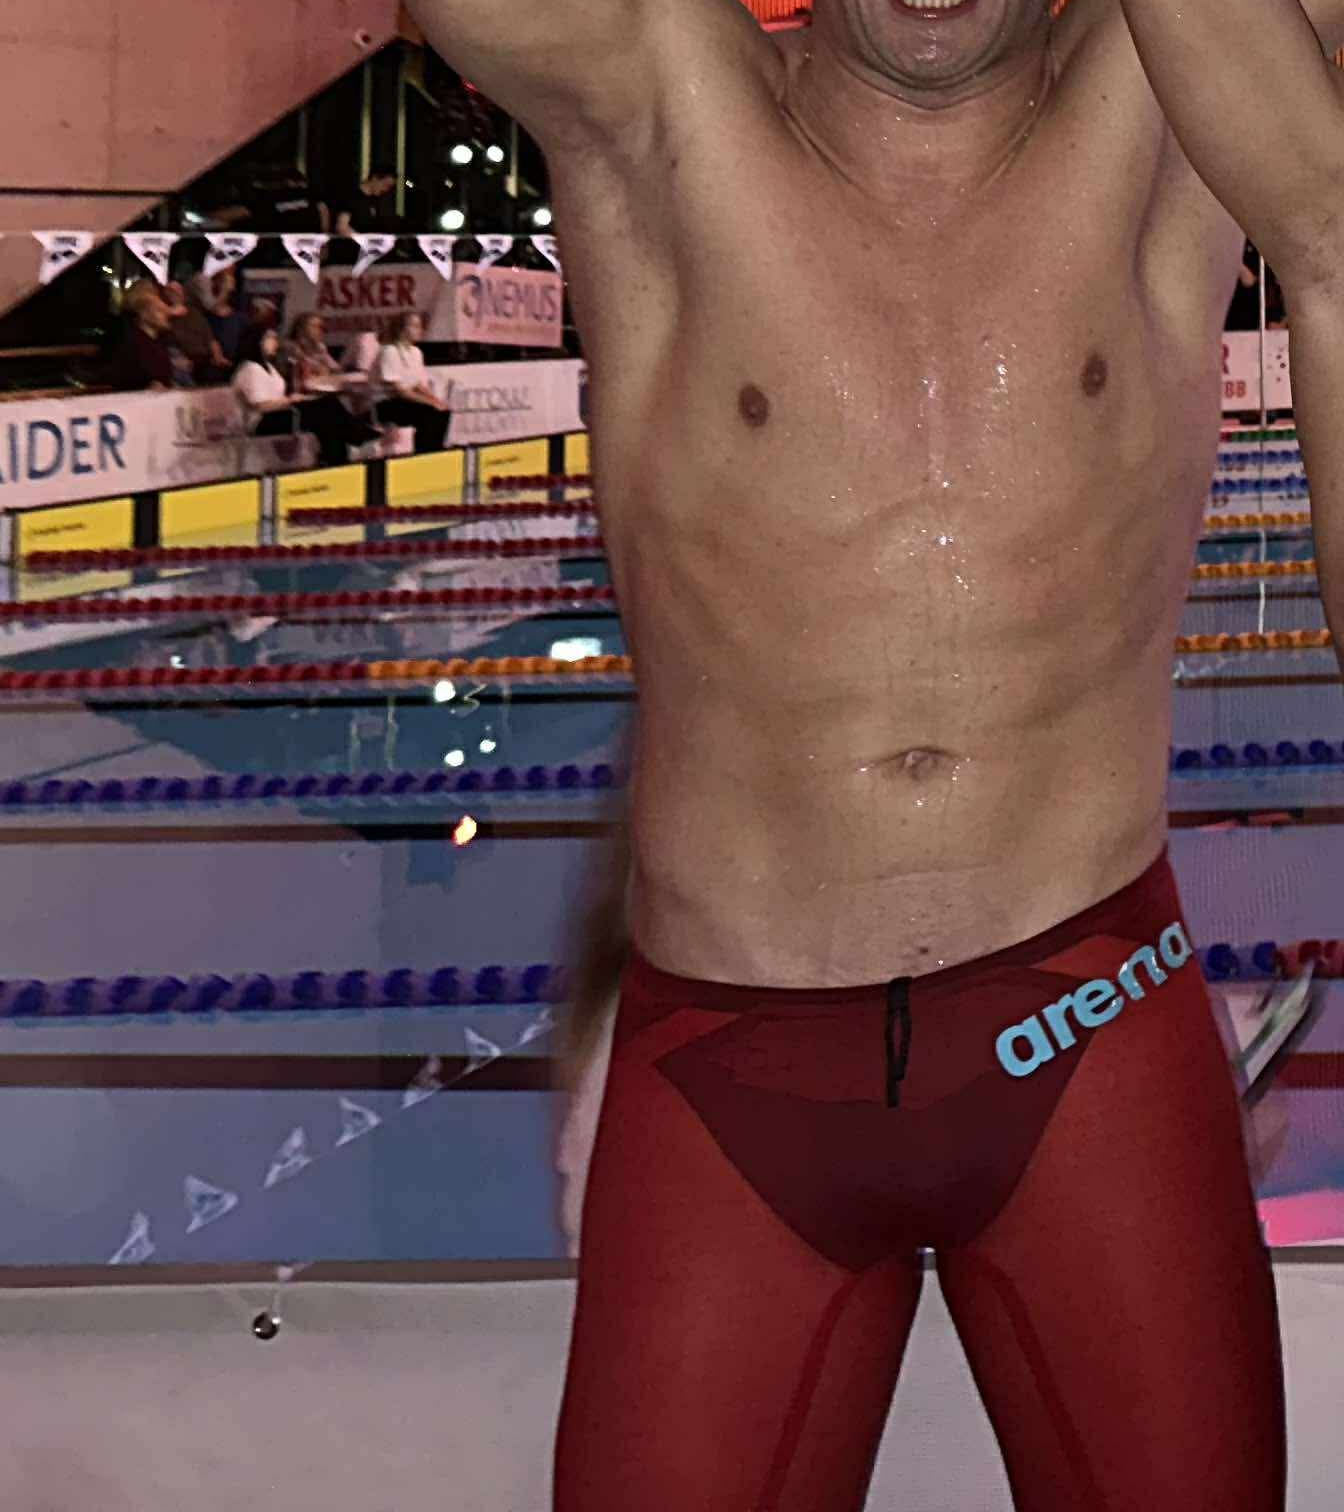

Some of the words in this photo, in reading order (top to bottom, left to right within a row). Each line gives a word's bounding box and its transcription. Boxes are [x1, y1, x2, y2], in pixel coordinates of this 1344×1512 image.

[317, 274, 417, 310] ASKER
[0, 413, 126, 484] IDER
[995, 921, 1193, 1078] arena
